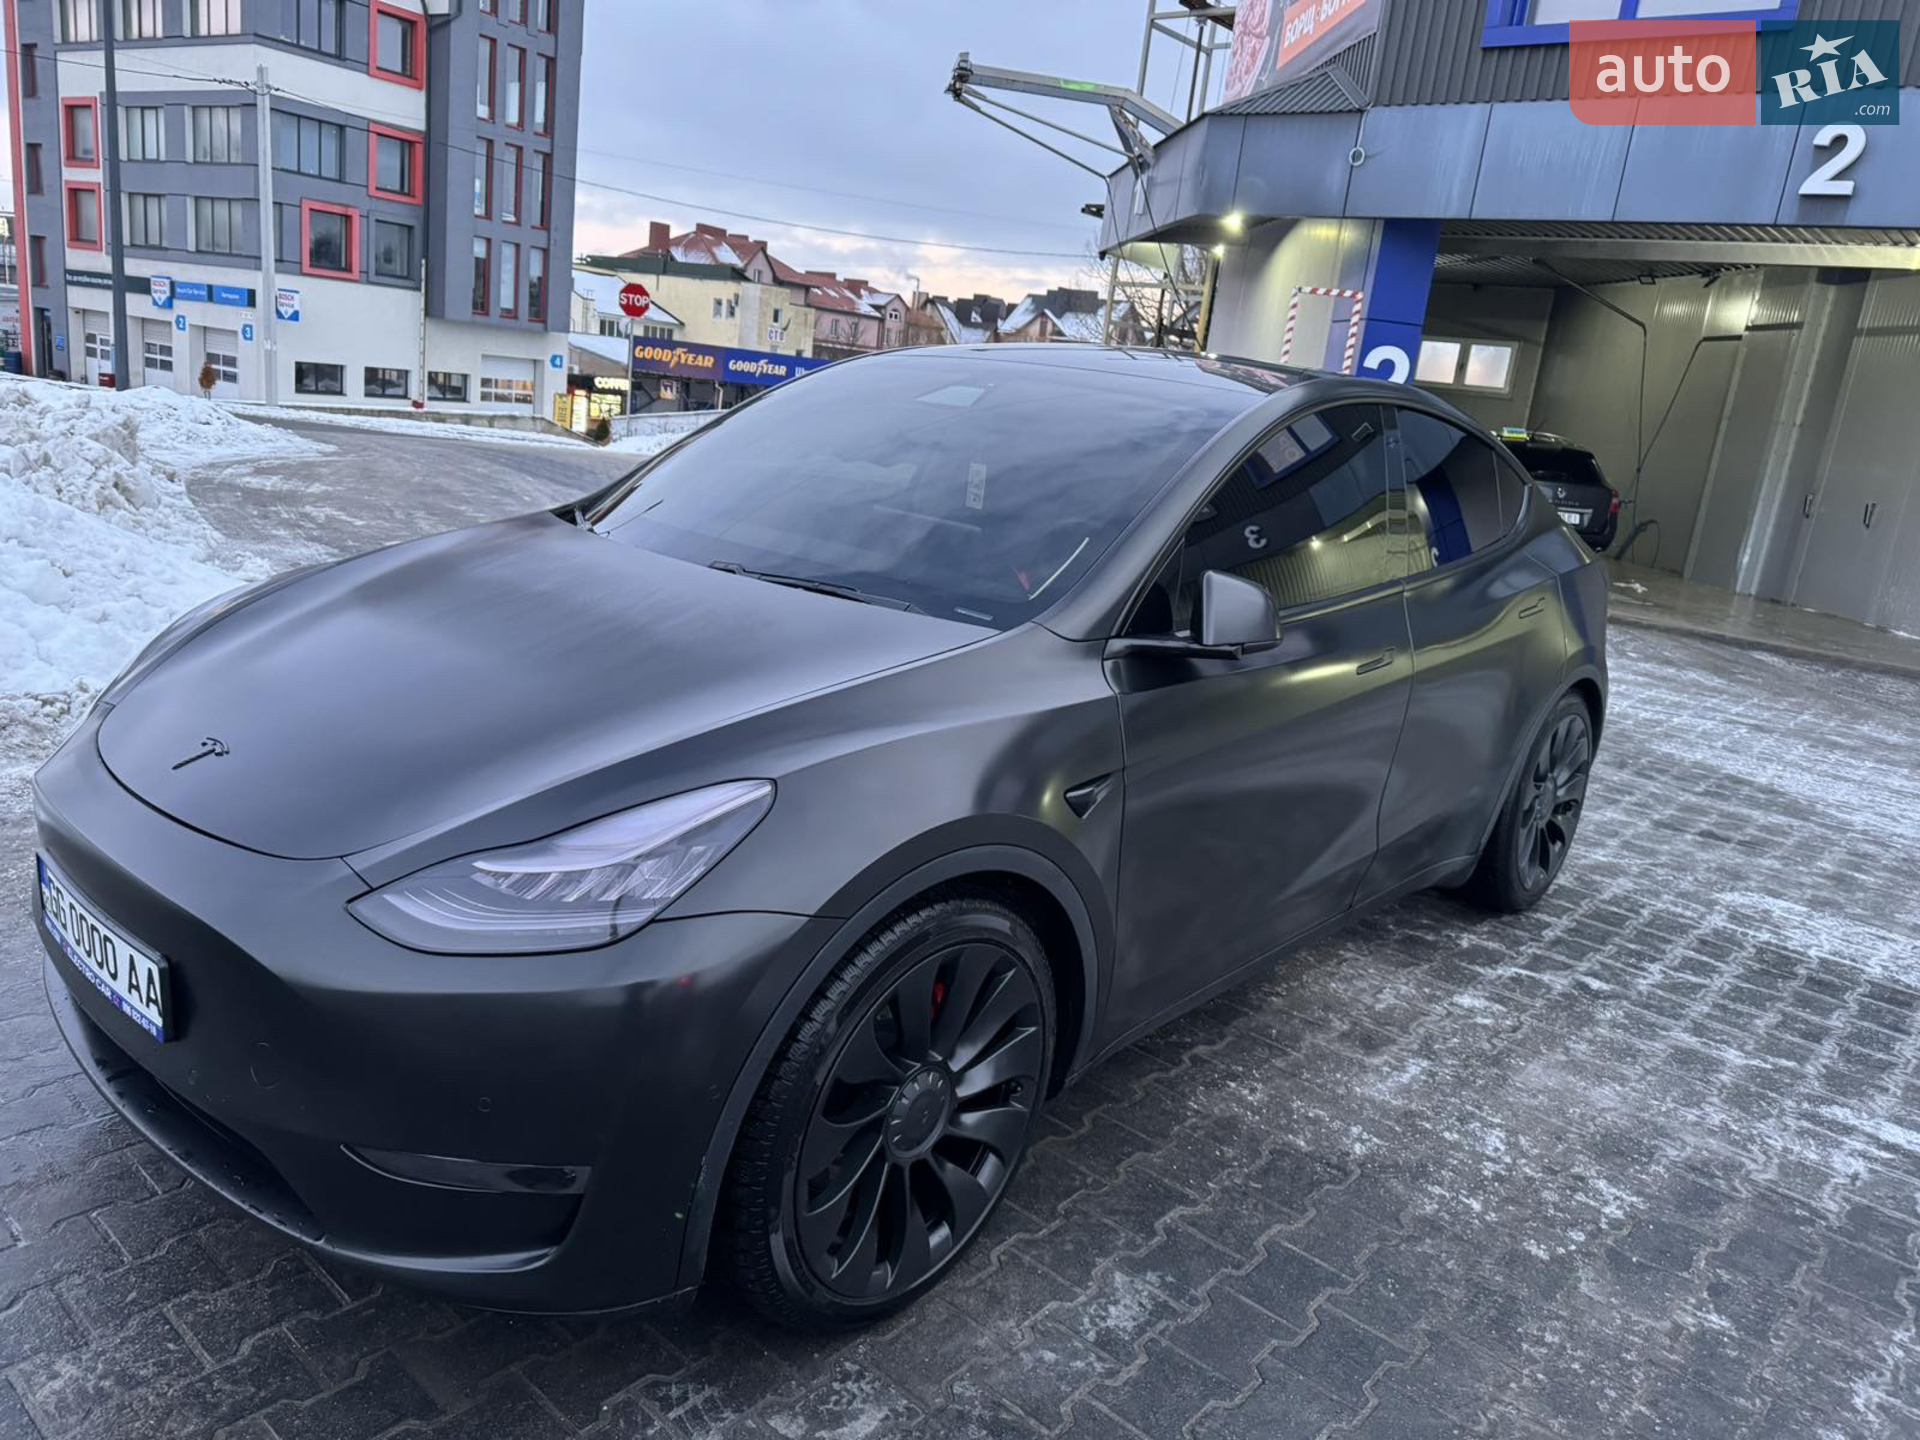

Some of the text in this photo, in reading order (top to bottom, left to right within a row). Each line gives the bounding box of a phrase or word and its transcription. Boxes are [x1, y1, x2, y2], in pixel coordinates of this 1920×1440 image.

[1798, 121, 1867, 196] 2
[278, 292, 295, 302] BOSCH
[620, 292, 650, 307] STOP
[245, 327, 251, 337] 3
[634, 345, 715, 368] GOODYEAR
[728, 359, 787, 377] GOODYEAR
[69, 902, 118, 982] 0000
[128, 953, 162, 1019] AA
